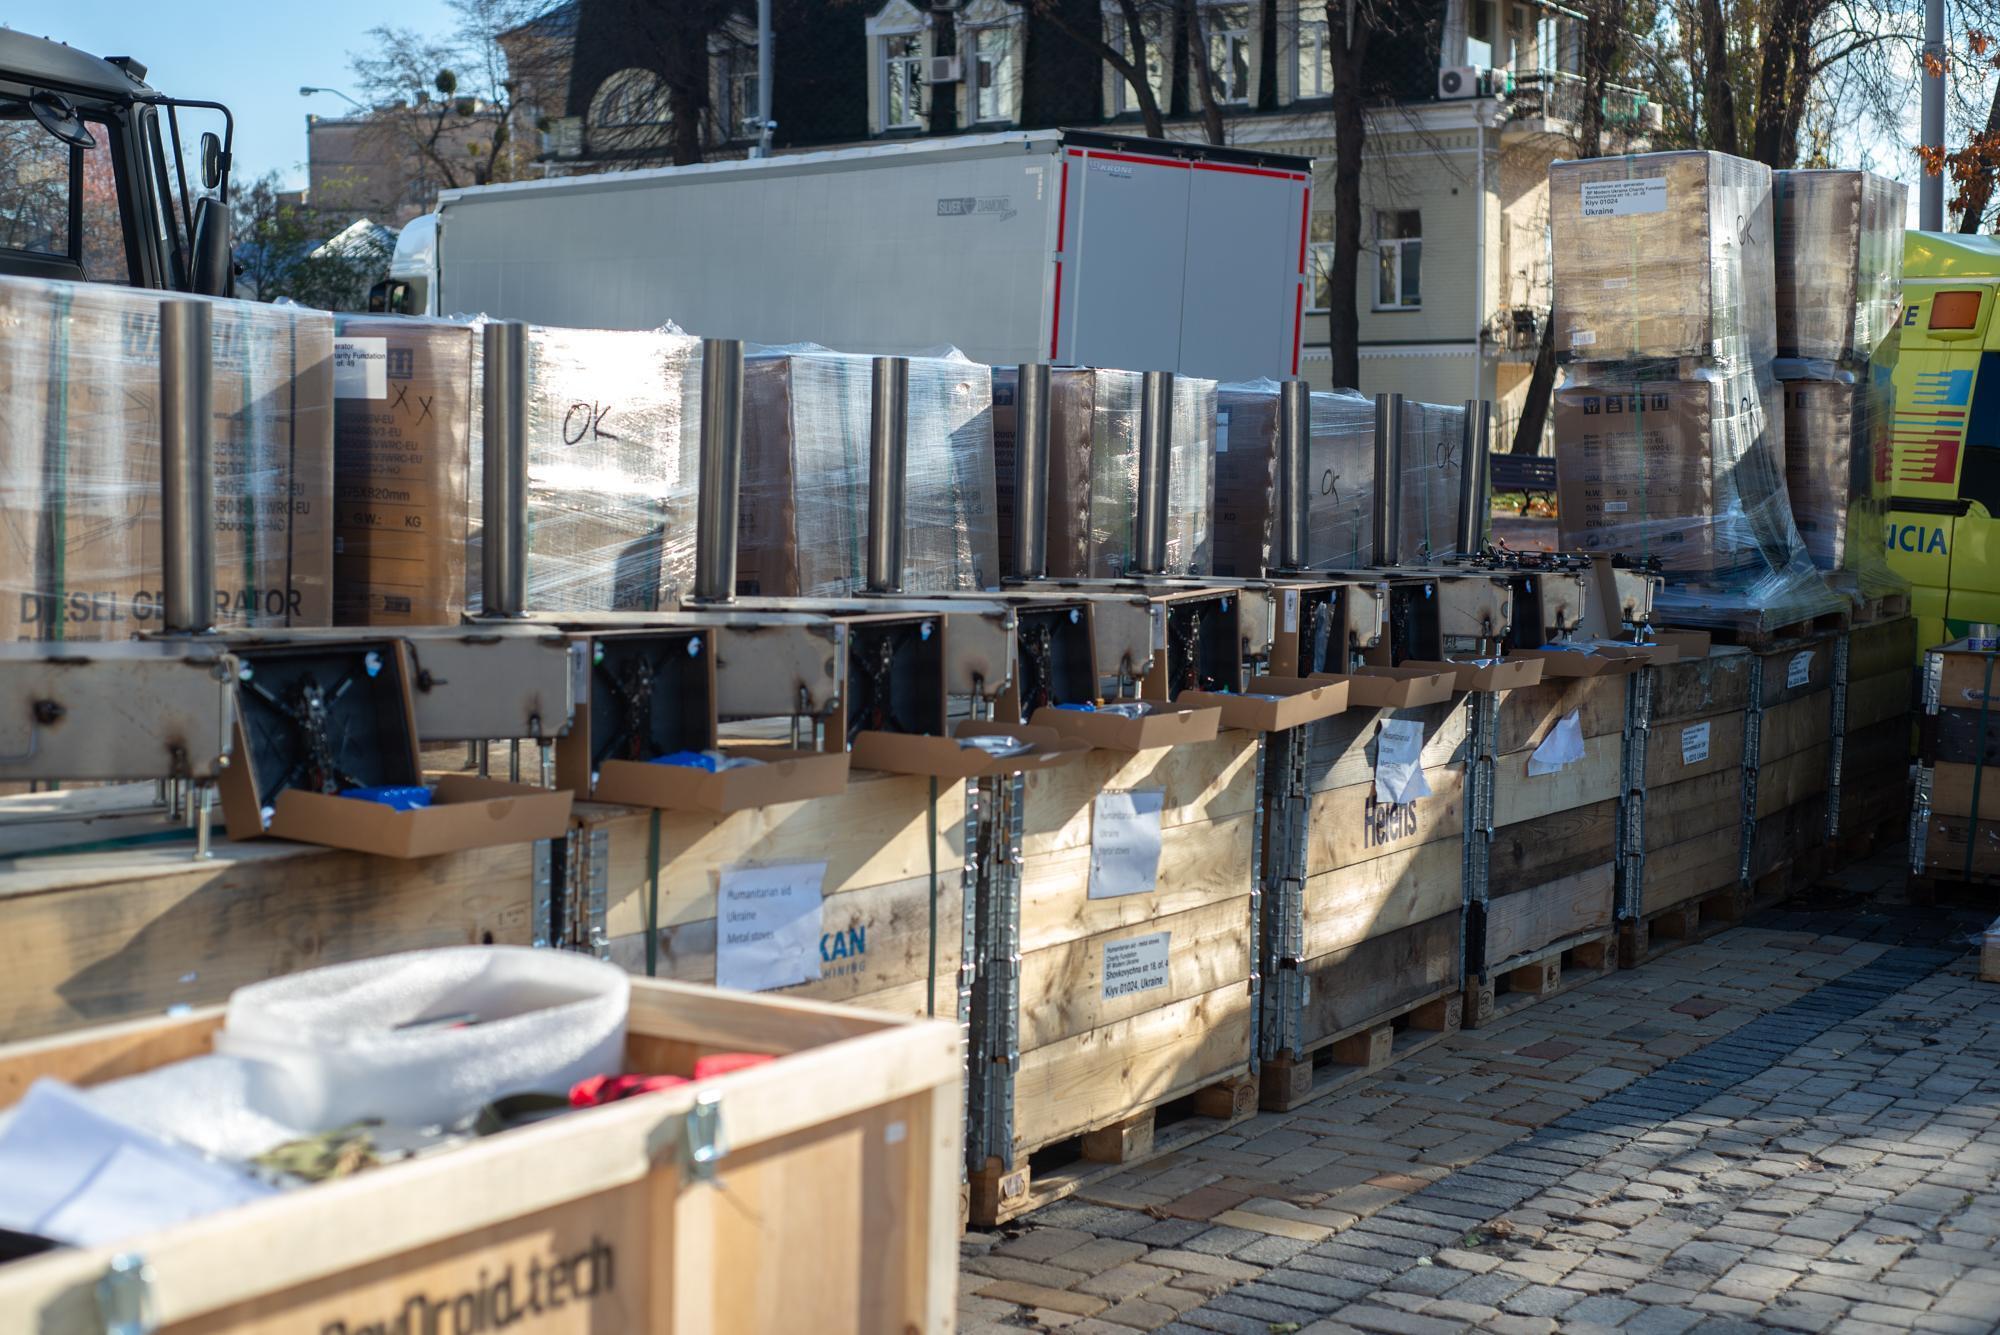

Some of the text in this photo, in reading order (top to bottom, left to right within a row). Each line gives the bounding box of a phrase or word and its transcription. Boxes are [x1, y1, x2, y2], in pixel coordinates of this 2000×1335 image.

[1585, 208, 1614, 216] Ukraine
[563, 400, 620, 446] OK
[1436, 442, 1460, 470] OK
[1321, 468, 1340, 504] OK
[404, 515, 422, 528] KG
[727, 886, 792, 900] Humanitarian aid
[727, 910, 757, 923] Ukraine
[727, 932, 749, 944] Metal
[1140, 976, 1163, 989] Ukraine
